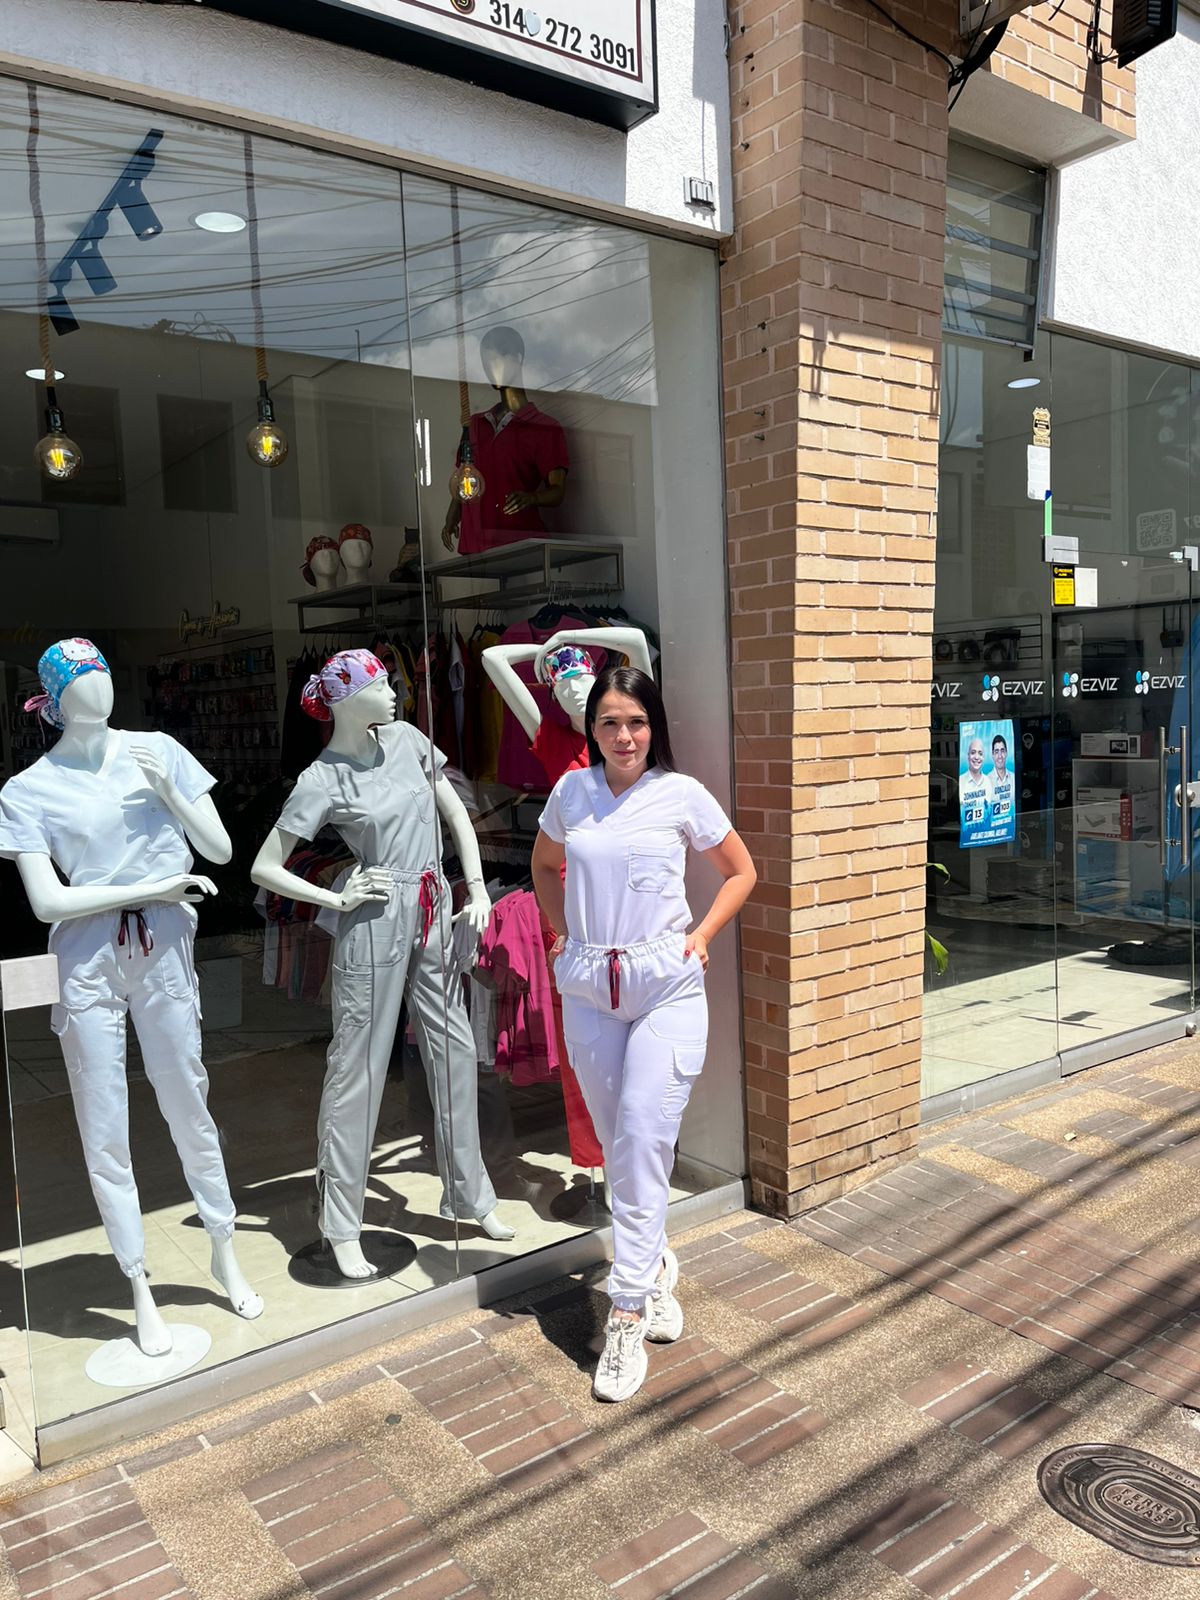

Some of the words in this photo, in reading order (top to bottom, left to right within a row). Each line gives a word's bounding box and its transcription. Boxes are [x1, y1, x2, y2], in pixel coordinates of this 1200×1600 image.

[545, 18, 582, 53] 272
[590, 33, 636, 72] 3091
[1002, 681, 1045, 696] EZVIZ
[1080, 677, 1119, 692] EZVIZ
[1151, 675, 1186, 689] EZVIZ
[975, 809, 982, 818] 13
[1112, 1494, 1165, 1523] AGUAS
[1121, 1488, 1174, 1516] FERRE
